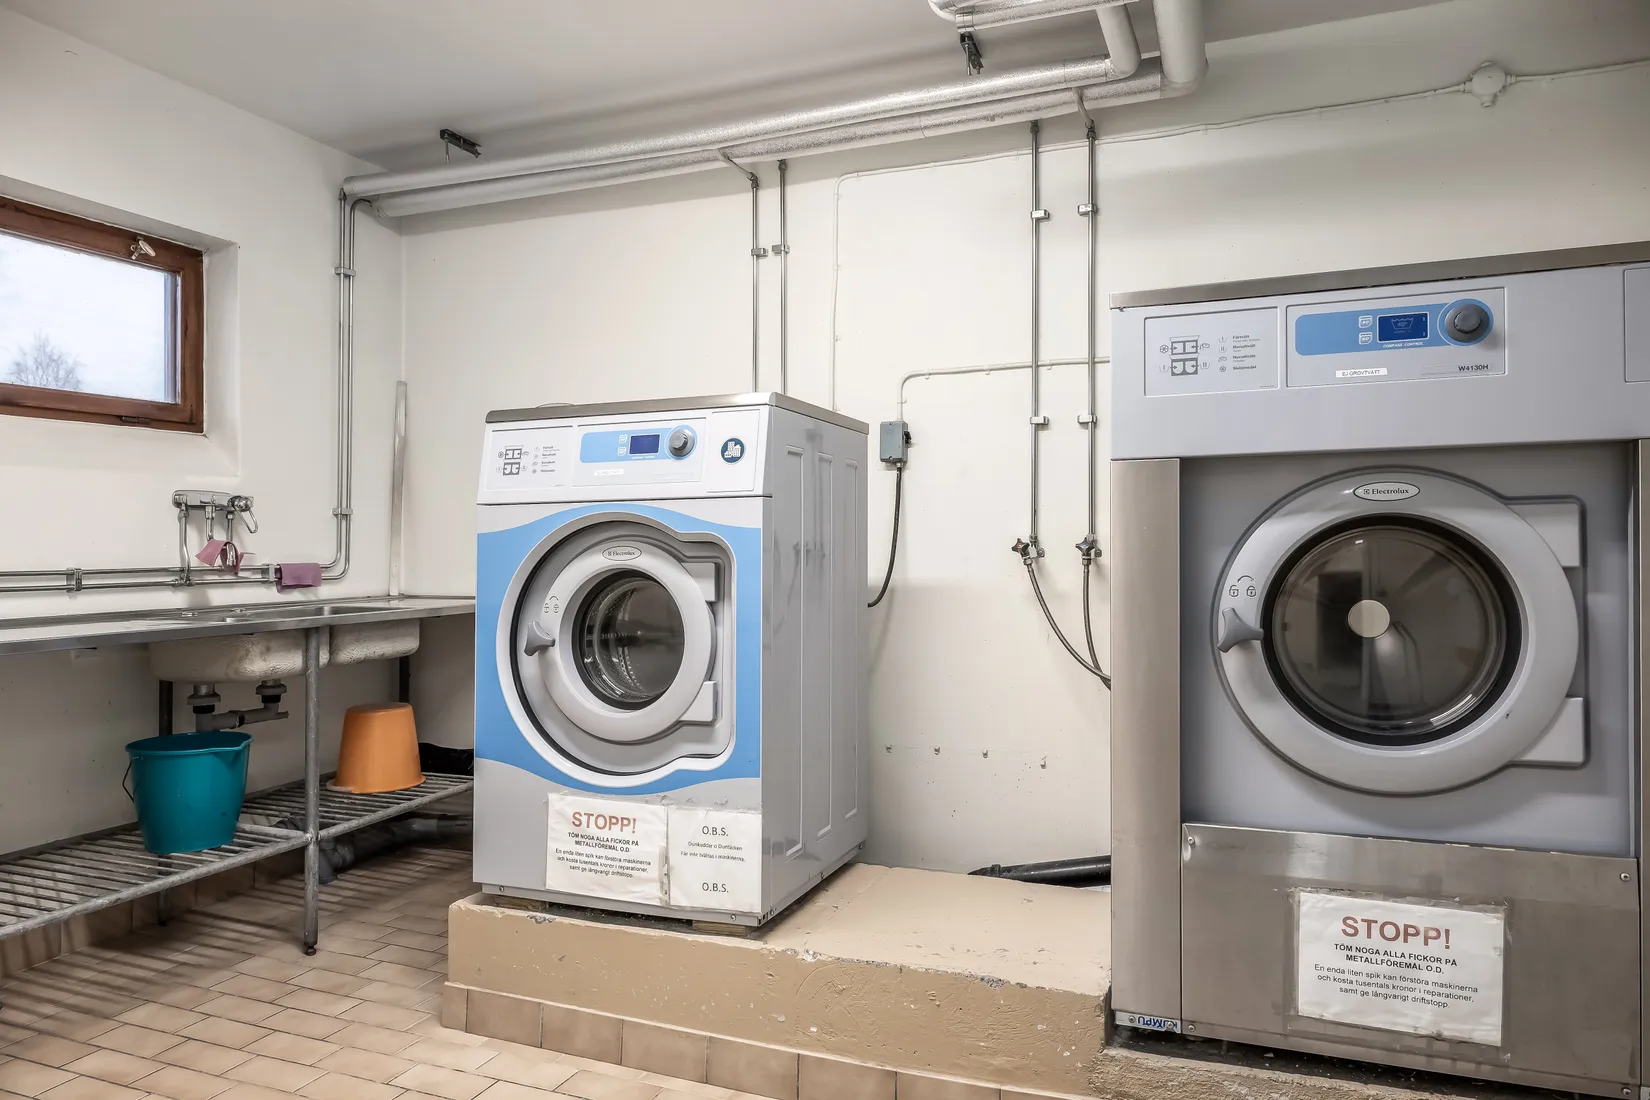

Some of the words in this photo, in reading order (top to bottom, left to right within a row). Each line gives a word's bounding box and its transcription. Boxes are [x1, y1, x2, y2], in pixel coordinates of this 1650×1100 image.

[1458, 364, 1489, 372] W4130H
[572, 812, 636, 833] STOPP!
[702, 826, 728, 836] O.B.S.
[575, 840, 618, 851] METALLFÖREMÅL
[611, 838, 630, 846] FICKOR
[579, 859, 599, 867] tusentals
[585, 851, 594, 859] spik
[605, 854, 622, 862] förstöra
[623, 857, 651, 865] maskinerna
[588, 866, 610, 875] långvarigt
[611, 869, 634, 878] driftstopp.
[702, 882, 728, 893] O.B.S.
[1341, 916, 1451, 949] STOPP!
[1334, 943, 1353, 952] TÖM
[1355, 946, 1380, 956] NOGA
[1383, 950, 1406, 959] ALLA
[1409, 953, 1442, 965] FICKOR
[1445, 957, 1457, 967] PÅ
[1346, 954, 1423, 971] METALLFÖREMÅL
[1426, 965, 1444, 974] O.D.
[1315, 964, 1324, 972] En
[1327, 966, 1345, 974] enda
[1348, 969, 1363, 977] liten
[1366, 971, 1380, 980] spik
[1383, 973, 1397, 981] kan
[1399, 975, 1429, 986] förstöra
[1431, 980, 1478, 993] maskinerna
[1318, 974, 1331, 982] och
[1333, 976, 1353, 985] kosta
[1356, 978, 1389, 990] tusentals
[1392, 983, 1417, 993] kronor
[1339, 986, 1358, 995] samt
[1360, 989, 1369, 998] ge
[1371, 990, 1409, 1003] långvarigt
[1411, 994, 1450, 1009] driftstopp.
